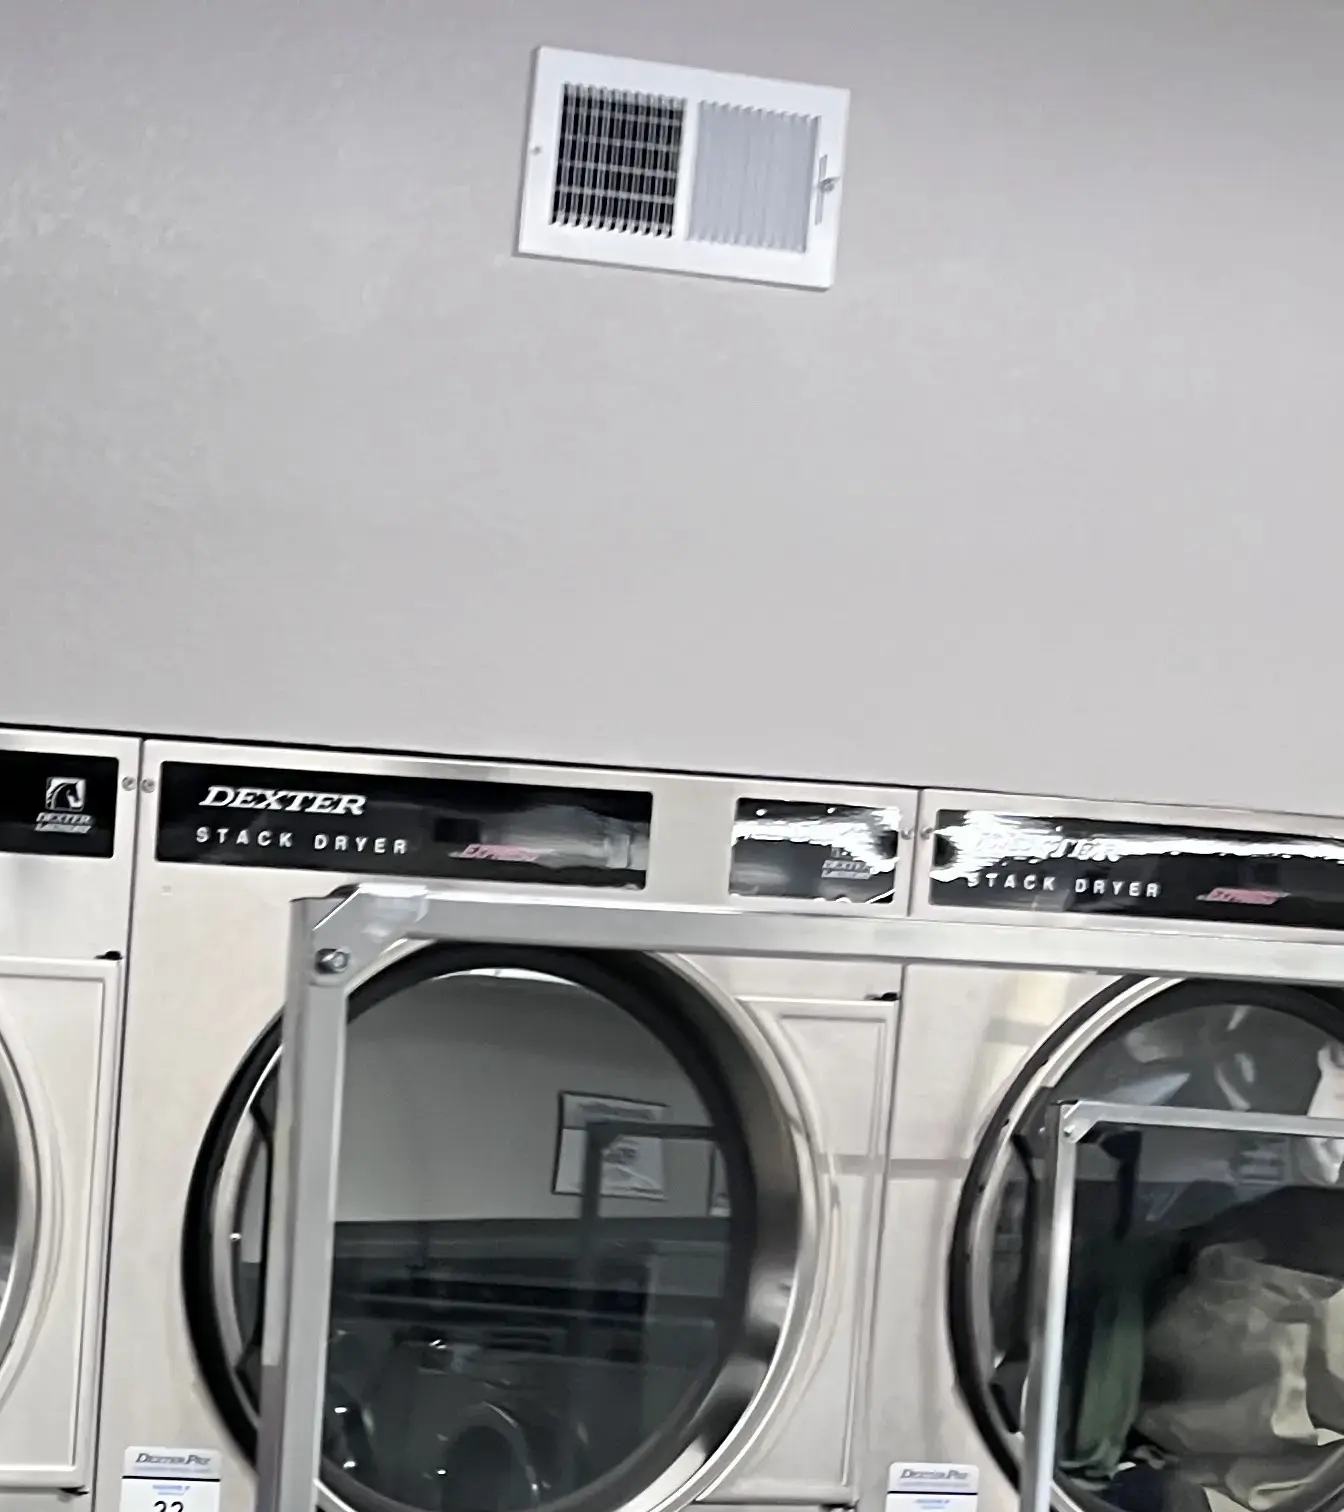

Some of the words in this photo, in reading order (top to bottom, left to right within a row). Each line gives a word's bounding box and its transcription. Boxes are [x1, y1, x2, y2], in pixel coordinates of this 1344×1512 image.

[199, 785, 367, 816] DEXTER
[195, 825, 295, 849] STACK
[314, 831, 409, 855] DRYER
[967, 872, 1056, 891] STACK
[1075, 878, 1160, 898] DRYER
